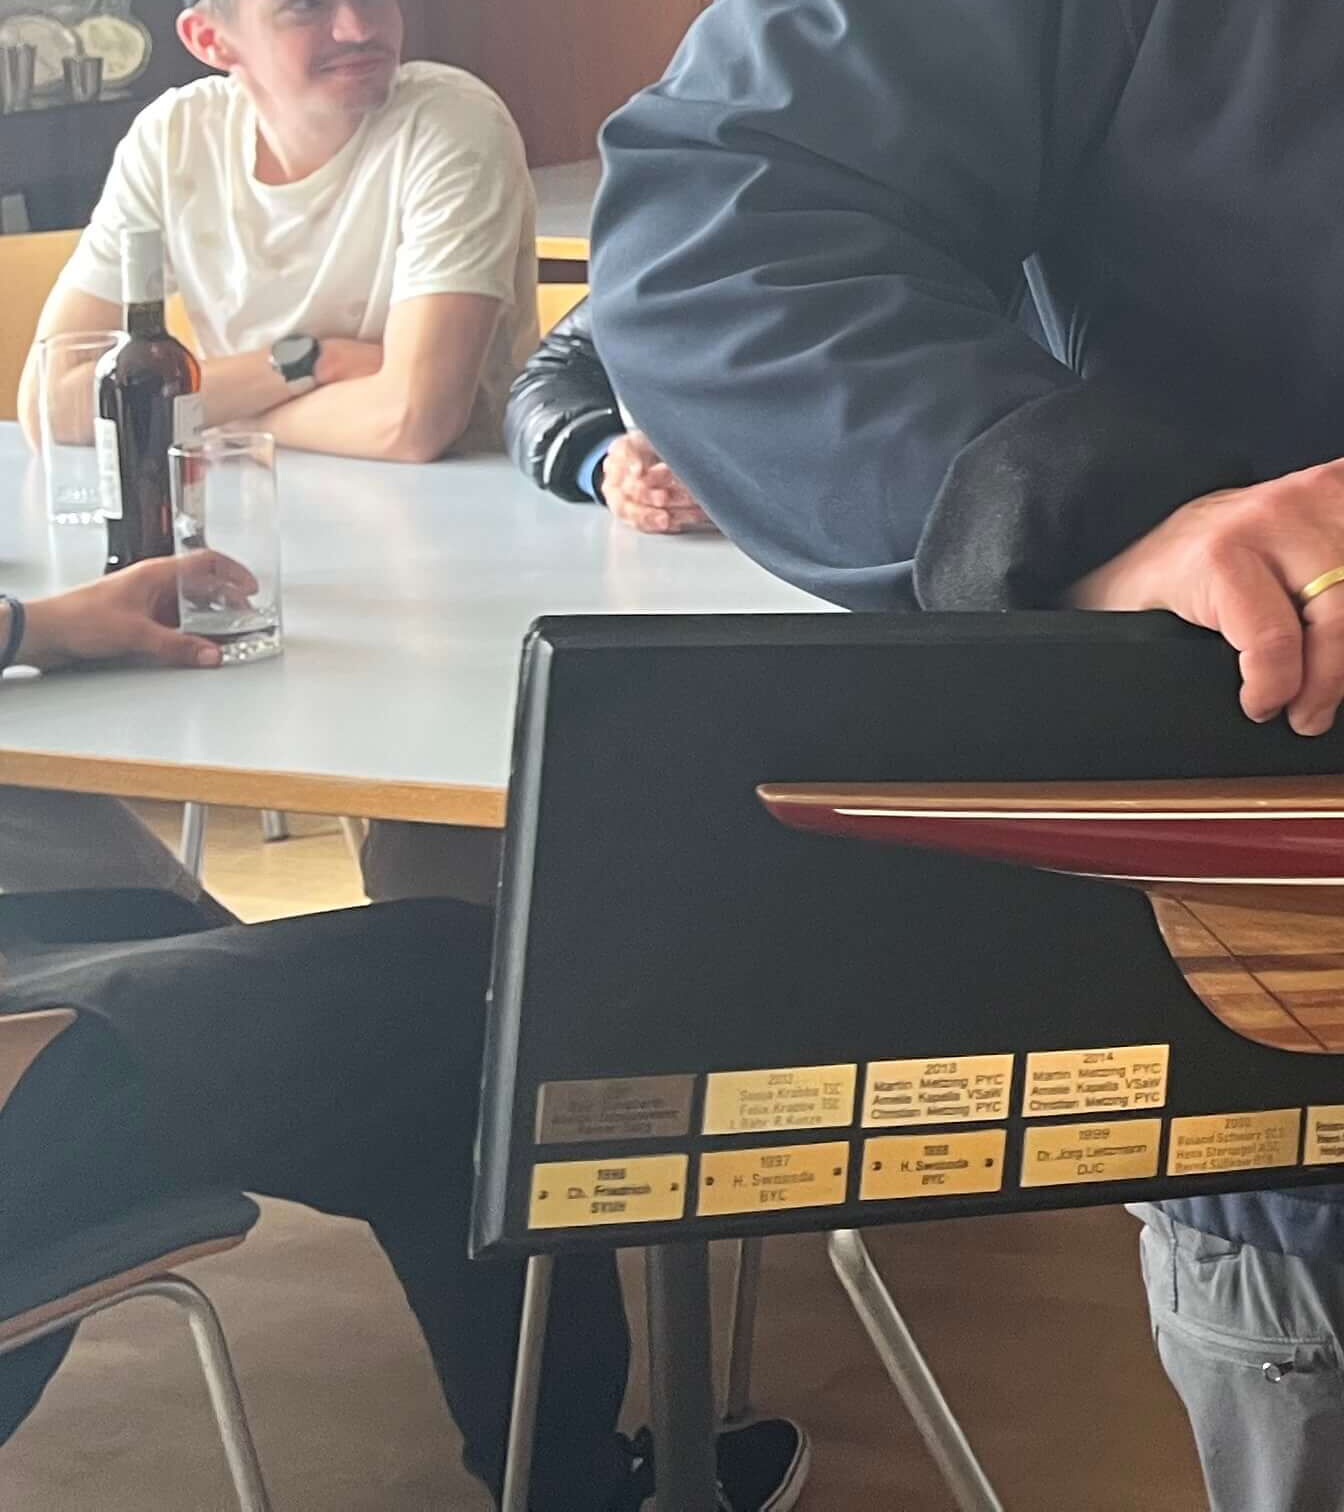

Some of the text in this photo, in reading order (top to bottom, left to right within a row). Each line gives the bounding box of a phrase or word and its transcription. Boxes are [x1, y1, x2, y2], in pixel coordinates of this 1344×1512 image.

[1132, 1062, 1162, 1075] PYC
[975, 1073, 1006, 1086] PYC
[1133, 1091, 1161, 1104] PYC
[976, 1100, 1002, 1113] PYC
